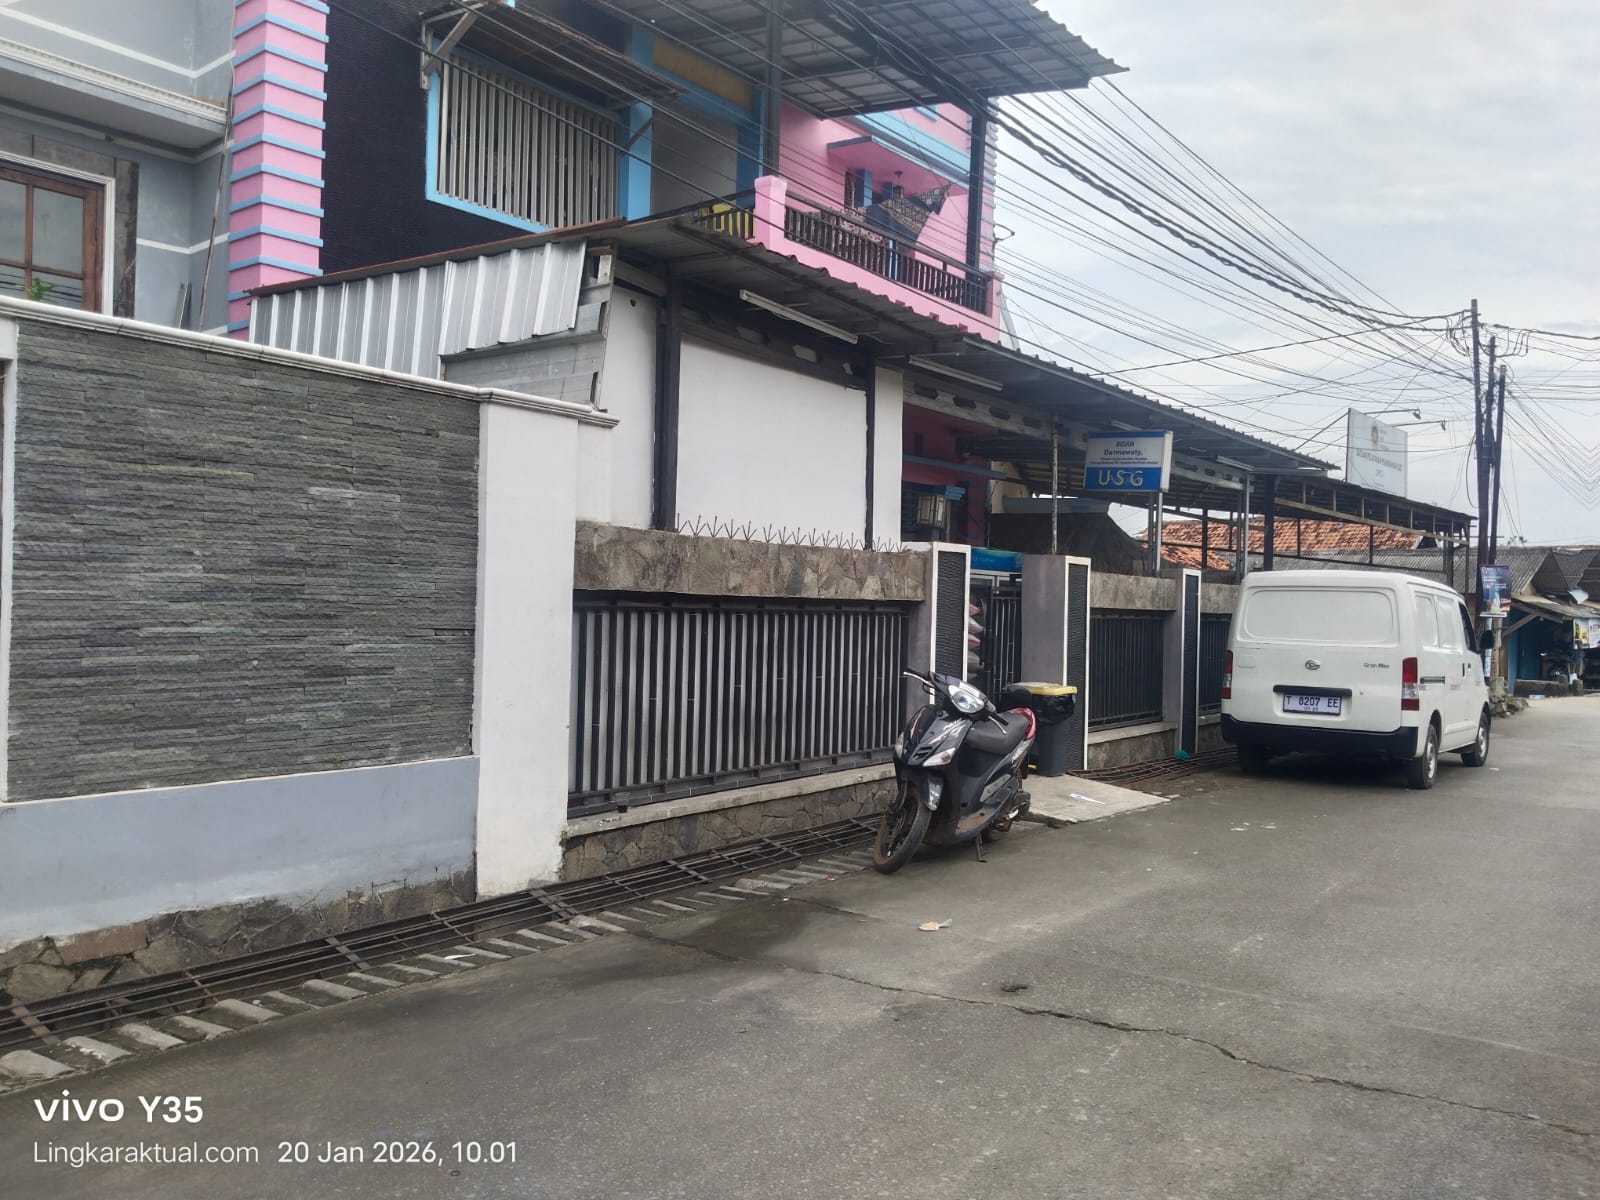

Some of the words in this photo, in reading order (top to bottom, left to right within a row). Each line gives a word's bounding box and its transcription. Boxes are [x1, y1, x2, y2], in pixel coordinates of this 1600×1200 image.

[1286, 695, 1293, 705] T
[1298, 696, 1321, 707] 8207
[1327, 698, 1339, 708] EE
